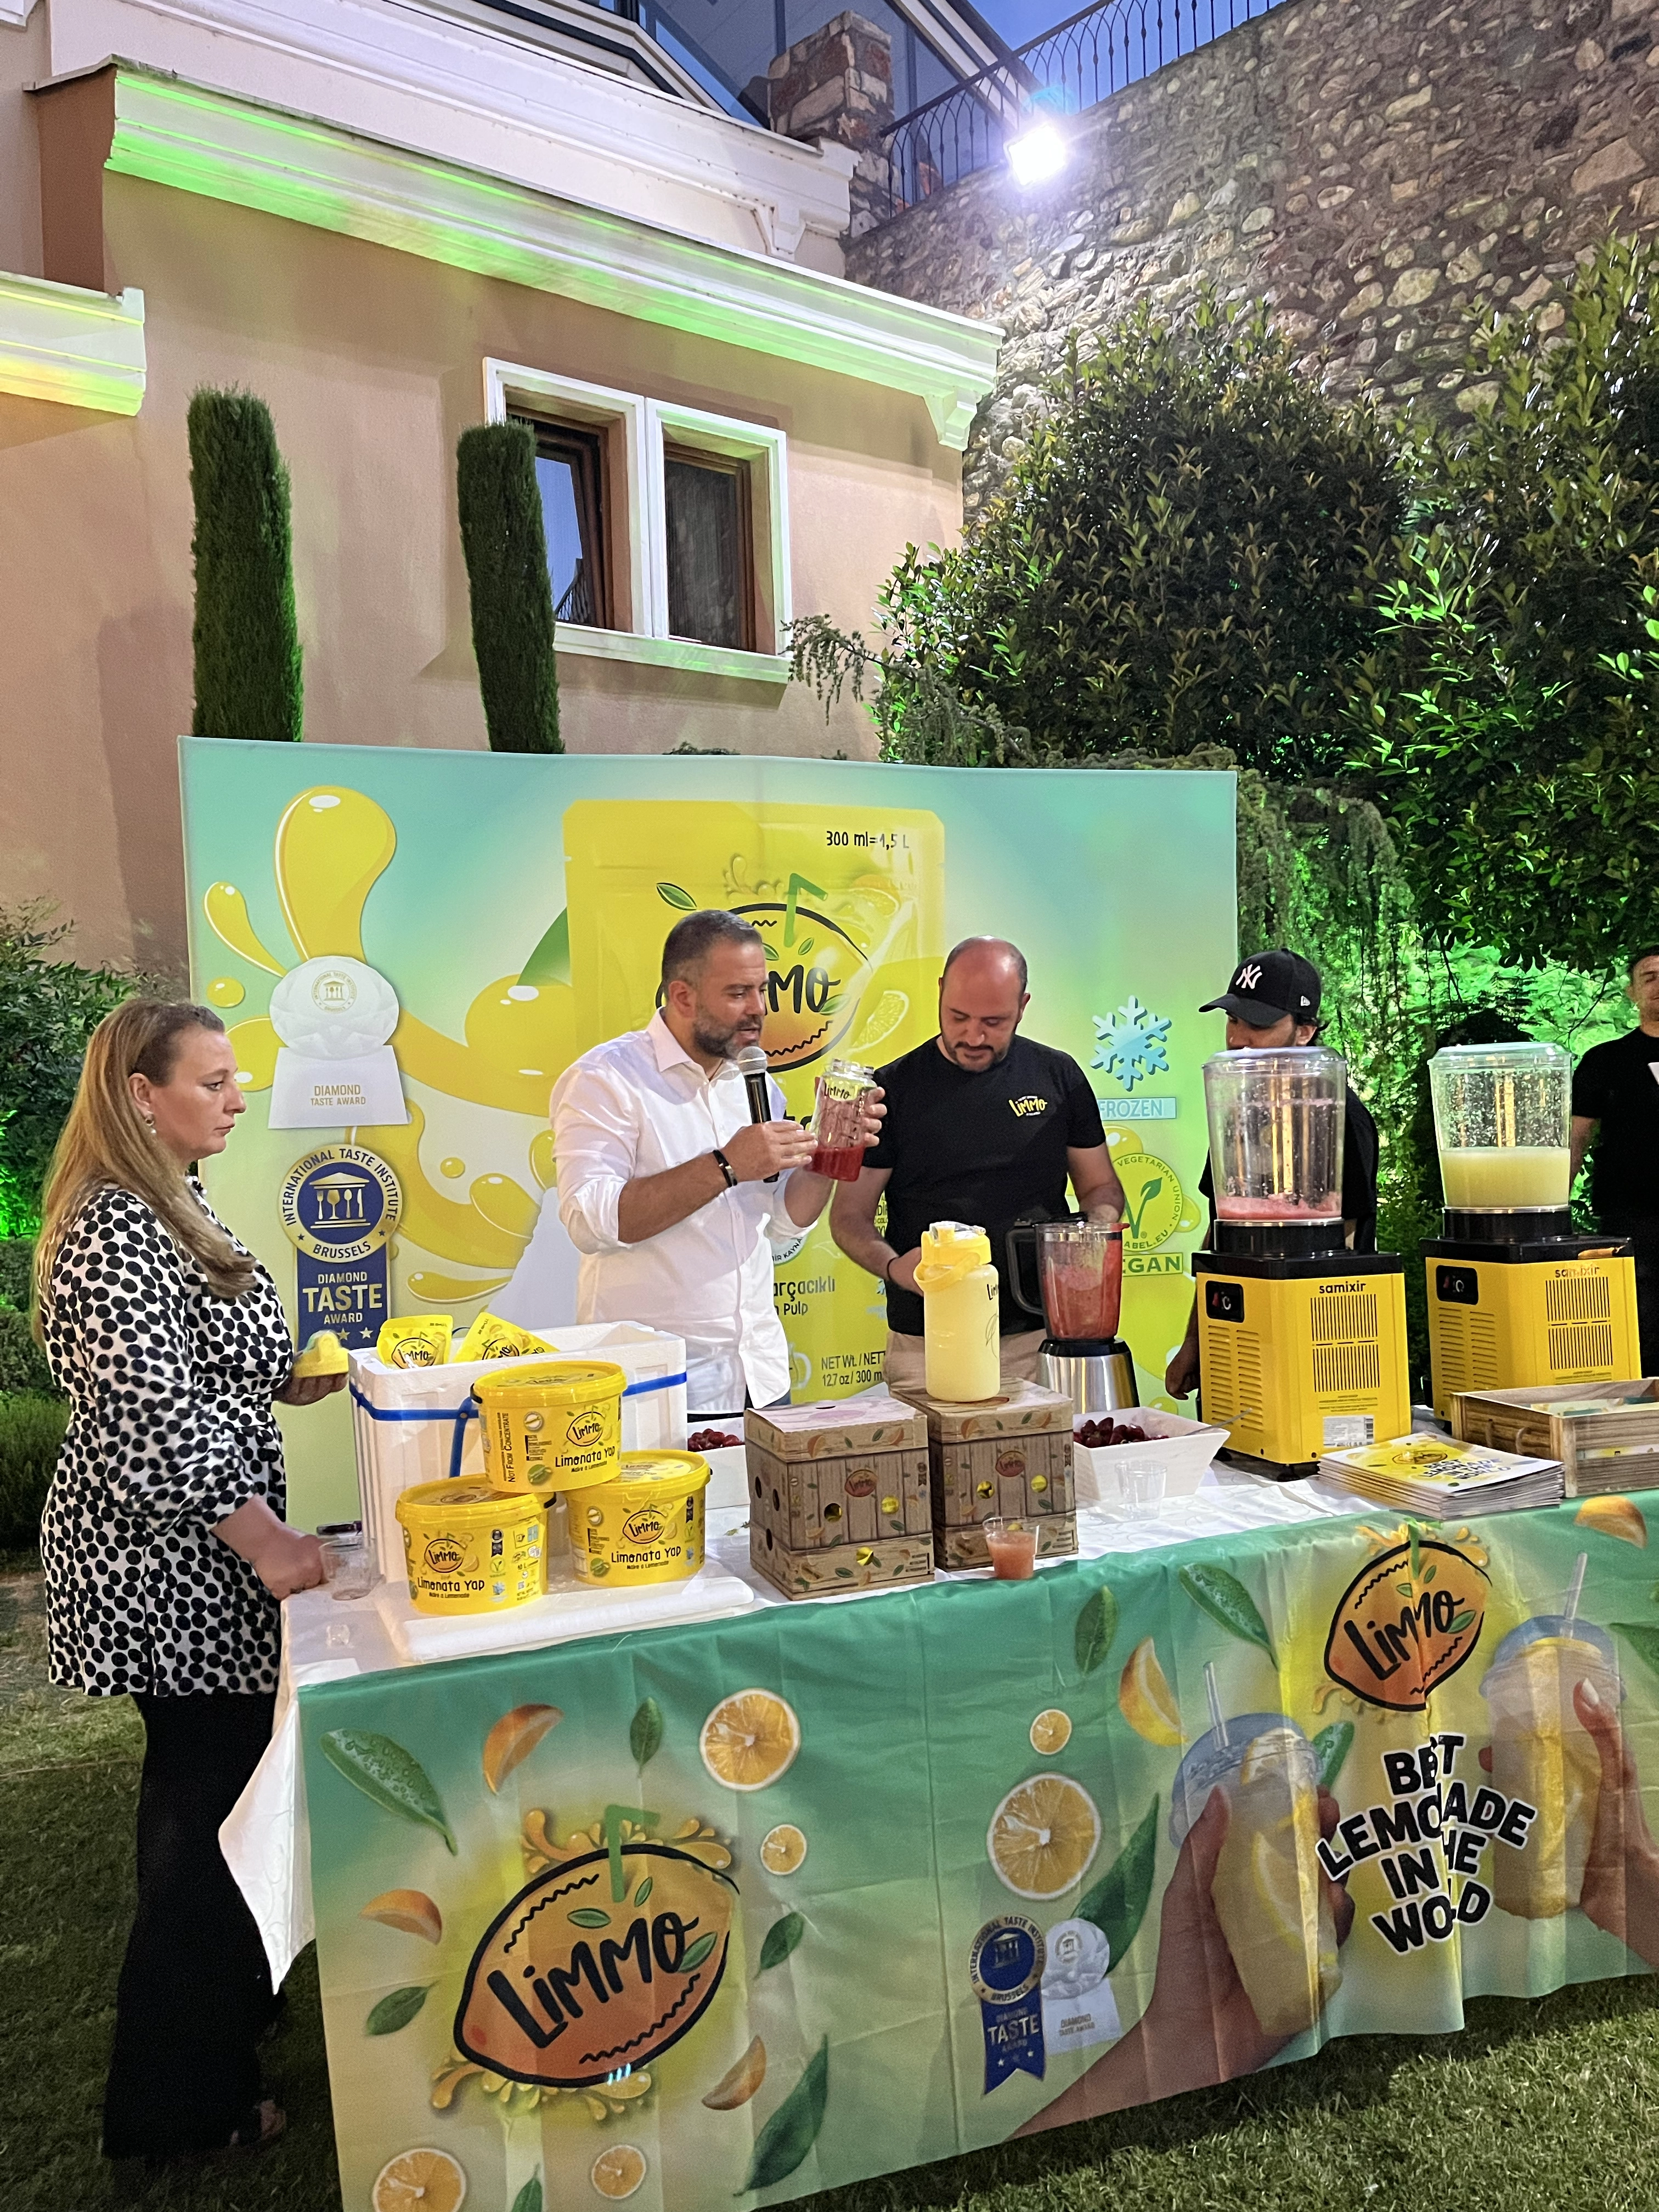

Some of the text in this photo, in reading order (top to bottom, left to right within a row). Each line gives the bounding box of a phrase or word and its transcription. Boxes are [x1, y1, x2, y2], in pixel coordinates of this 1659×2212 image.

[826, 831, 849, 845] 300
[334, 972, 346, 980] TASTE
[1235, 964, 1262, 989] NY
[314, 1085, 360, 1096] DIAMOND
[311, 1097, 366, 1106] TASTE AWARD
[1099, 1100, 1163, 1118] FROZEN
[283, 1148, 398, 1226] INTERNATIONAL TASTE INSTITUTE
[1117, 1156, 1181, 1221] VEGETARIAN UNION
[313, 1241, 371, 1258] BRUSSELS
[318, 1272, 368, 1284] DIAMOND
[1319, 1280, 1367, 1294] samixir
[302, 1283, 382, 1312] TASTE
[324, 1312, 363, 1324] AWARD
[821, 1356, 840, 1370] NET
[856, 1369, 871, 1383] 300
[555, 1446, 615, 1467] Limonata Yap
[628, 1521, 662, 1537] LiMMO
[611, 1546, 681, 1563] Limonata Yap
[417, 1576, 485, 1592] Limonata Yap
[1317, 1782, 1536, 1878] LEMOADE
[1381, 1848, 1440, 1899] IN
[1004, 1916, 1028, 1927] TASTE
[1371, 1878, 1491, 1953] WOD
[487, 1912, 699, 2049] LiMMO
[991, 1984, 1029, 2001] BRUSSELS
[988, 2013, 1040, 2046] TASTE
